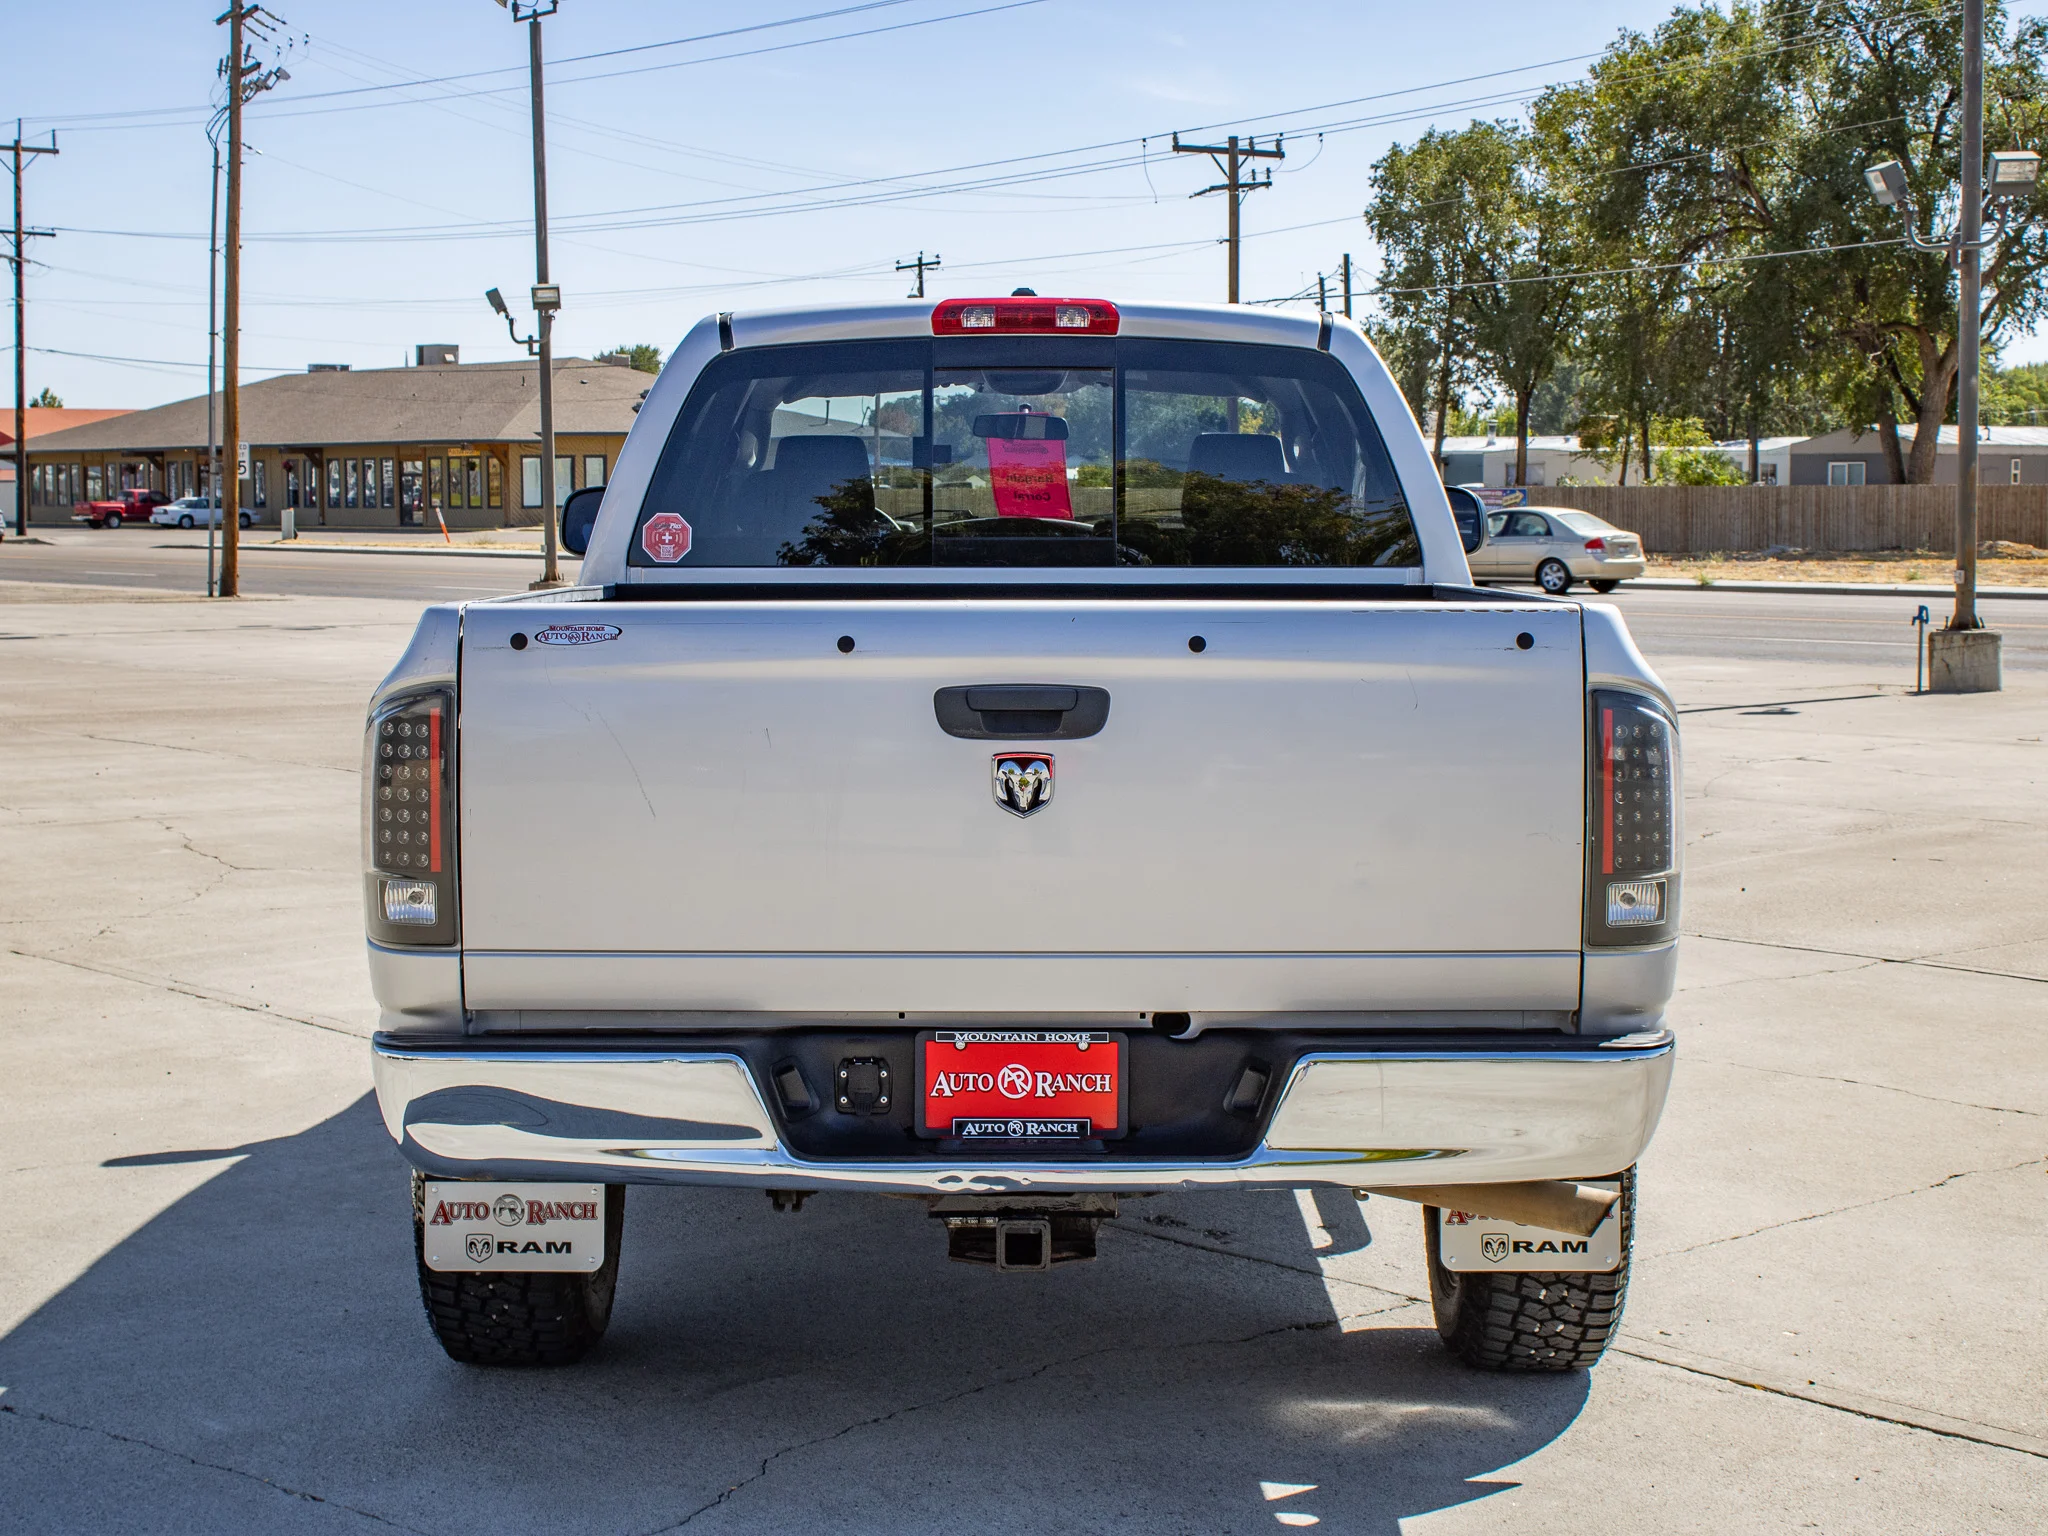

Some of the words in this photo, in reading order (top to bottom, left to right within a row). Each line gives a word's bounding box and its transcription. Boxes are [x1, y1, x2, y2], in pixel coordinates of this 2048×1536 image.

[539, 631, 567, 641] AUTO
[581, 632, 618, 641] RANCH
[955, 1033, 1038, 1041] MOUNTAIN
[1044, 1033, 1091, 1041] HOME
[930, 1071, 994, 1097] AUTO
[1034, 1072, 1111, 1097] RANCH
[962, 1122, 1004, 1135] AUTO
[1026, 1122, 1078, 1135] RANCH
[430, 1199, 490, 1226] AUTO
[526, 1200, 598, 1225] RANCH
[498, 1241, 572, 1254] RAM
[1513, 1241, 1588, 1253] RAM
